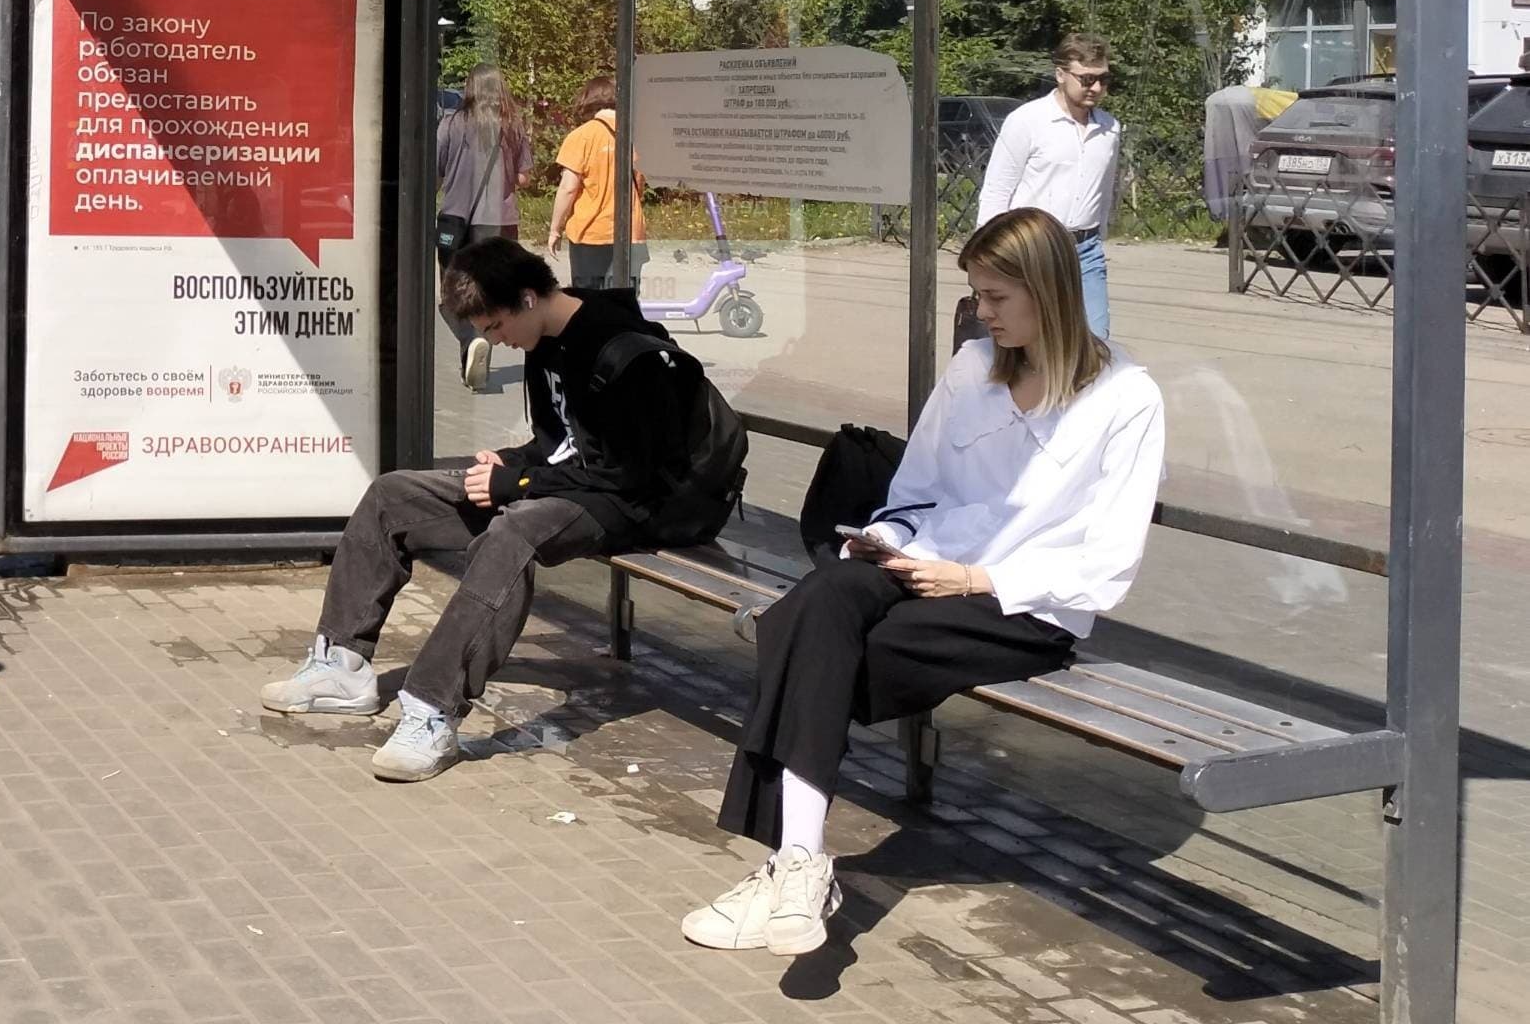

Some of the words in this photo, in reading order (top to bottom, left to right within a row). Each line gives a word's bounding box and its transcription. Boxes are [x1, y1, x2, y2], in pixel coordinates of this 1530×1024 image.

[79, 11, 114, 31] По
[123, 15, 210, 39] закону
[78, 37, 256, 62] работодатель
[77, 64, 168, 84] обязан
[77, 91, 257, 113] предоставить
[75, 115, 122, 136] для
[131, 118, 309, 139] прохождения
[74, 143, 320, 166] диспансеризации
[74, 166, 272, 187] оплачиваемый
[74, 193, 144, 213] день.
[173, 271, 354, 302] ВОСПОЛЬЗУЙТЕСЬ
[234, 310, 289, 336] ЭТИМ
[74, 369, 148, 385] Заботьтесь
[151, 372, 159, 382] о
[163, 370, 204, 383] своём
[80, 387, 143, 399] здоровье
[146, 387, 204, 399] вовремя
[142, 436, 353, 457] ЗДРАВООХРАНЕНИЕ
